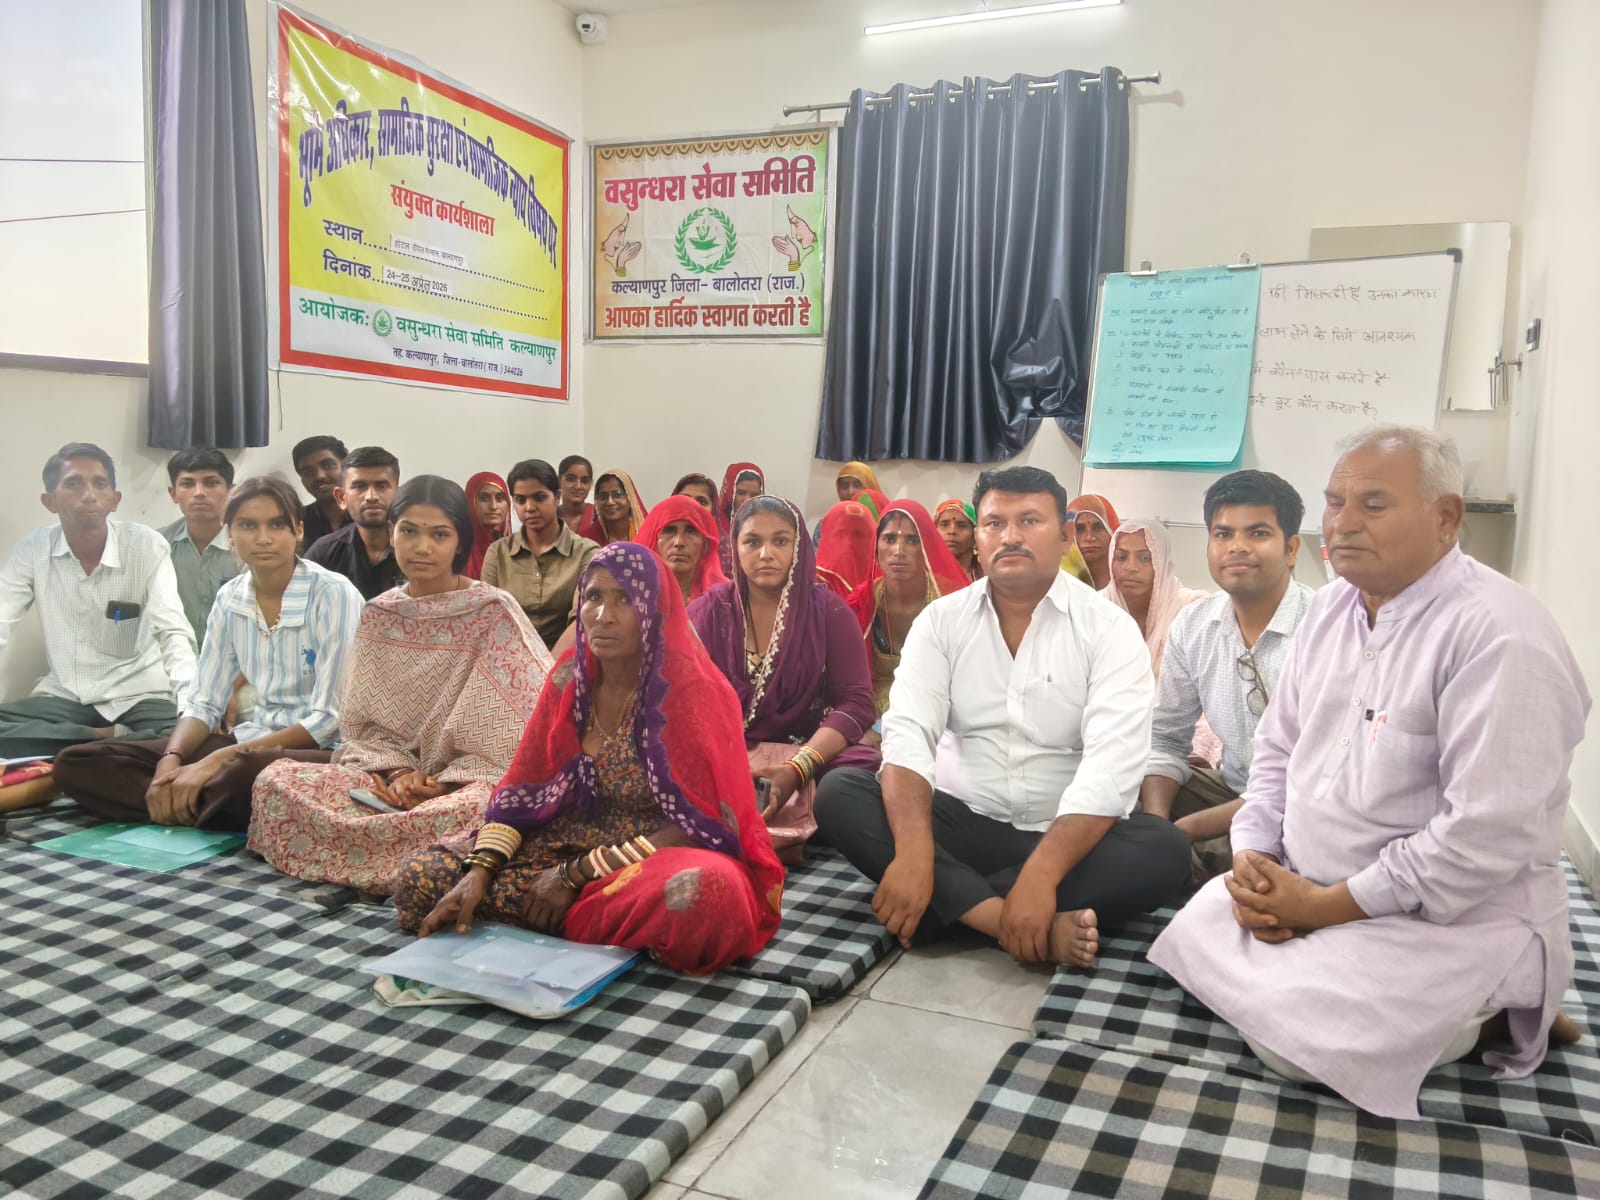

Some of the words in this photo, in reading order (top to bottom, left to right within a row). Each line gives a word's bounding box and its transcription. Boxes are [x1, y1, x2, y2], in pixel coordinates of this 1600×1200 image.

[378, 97, 424, 156] सामाजिक
[427, 115, 453, 176] सुरक्षा
[454, 117, 468, 172] एवं
[467, 135, 508, 202] सामाजिक
[509, 165, 528, 227] न्याय
[548, 215, 557, 270] पर
[604, 175, 686, 211] वसुन्धरा
[692, 162, 737, 199] सेवा
[742, 155, 816, 197] समिति
[391, 180, 434, 219] संयुक्त
[436, 200, 495, 236] कार्यशाला
[323, 219, 364, 246] स्थान
[323, 248, 371, 279] दिनांक
[612, 279, 666, 299] कल्याणपुर
[713, 272, 762, 295] बालोतरा
[298, 297, 369, 326] आयोजक:
[396, 316, 442, 342] वसुन्धरा
[445, 322, 468, 344] सेवा
[471, 330, 504, 351] समिति
[509, 339, 558, 364] कल्याणपुर
[604, 305, 651, 328] आपका
[651, 296, 698, 328] हार्दिक
[701, 304, 751, 327] स्वागत
[753, 297, 795, 326] करती
[795, 297, 811, 326] है
